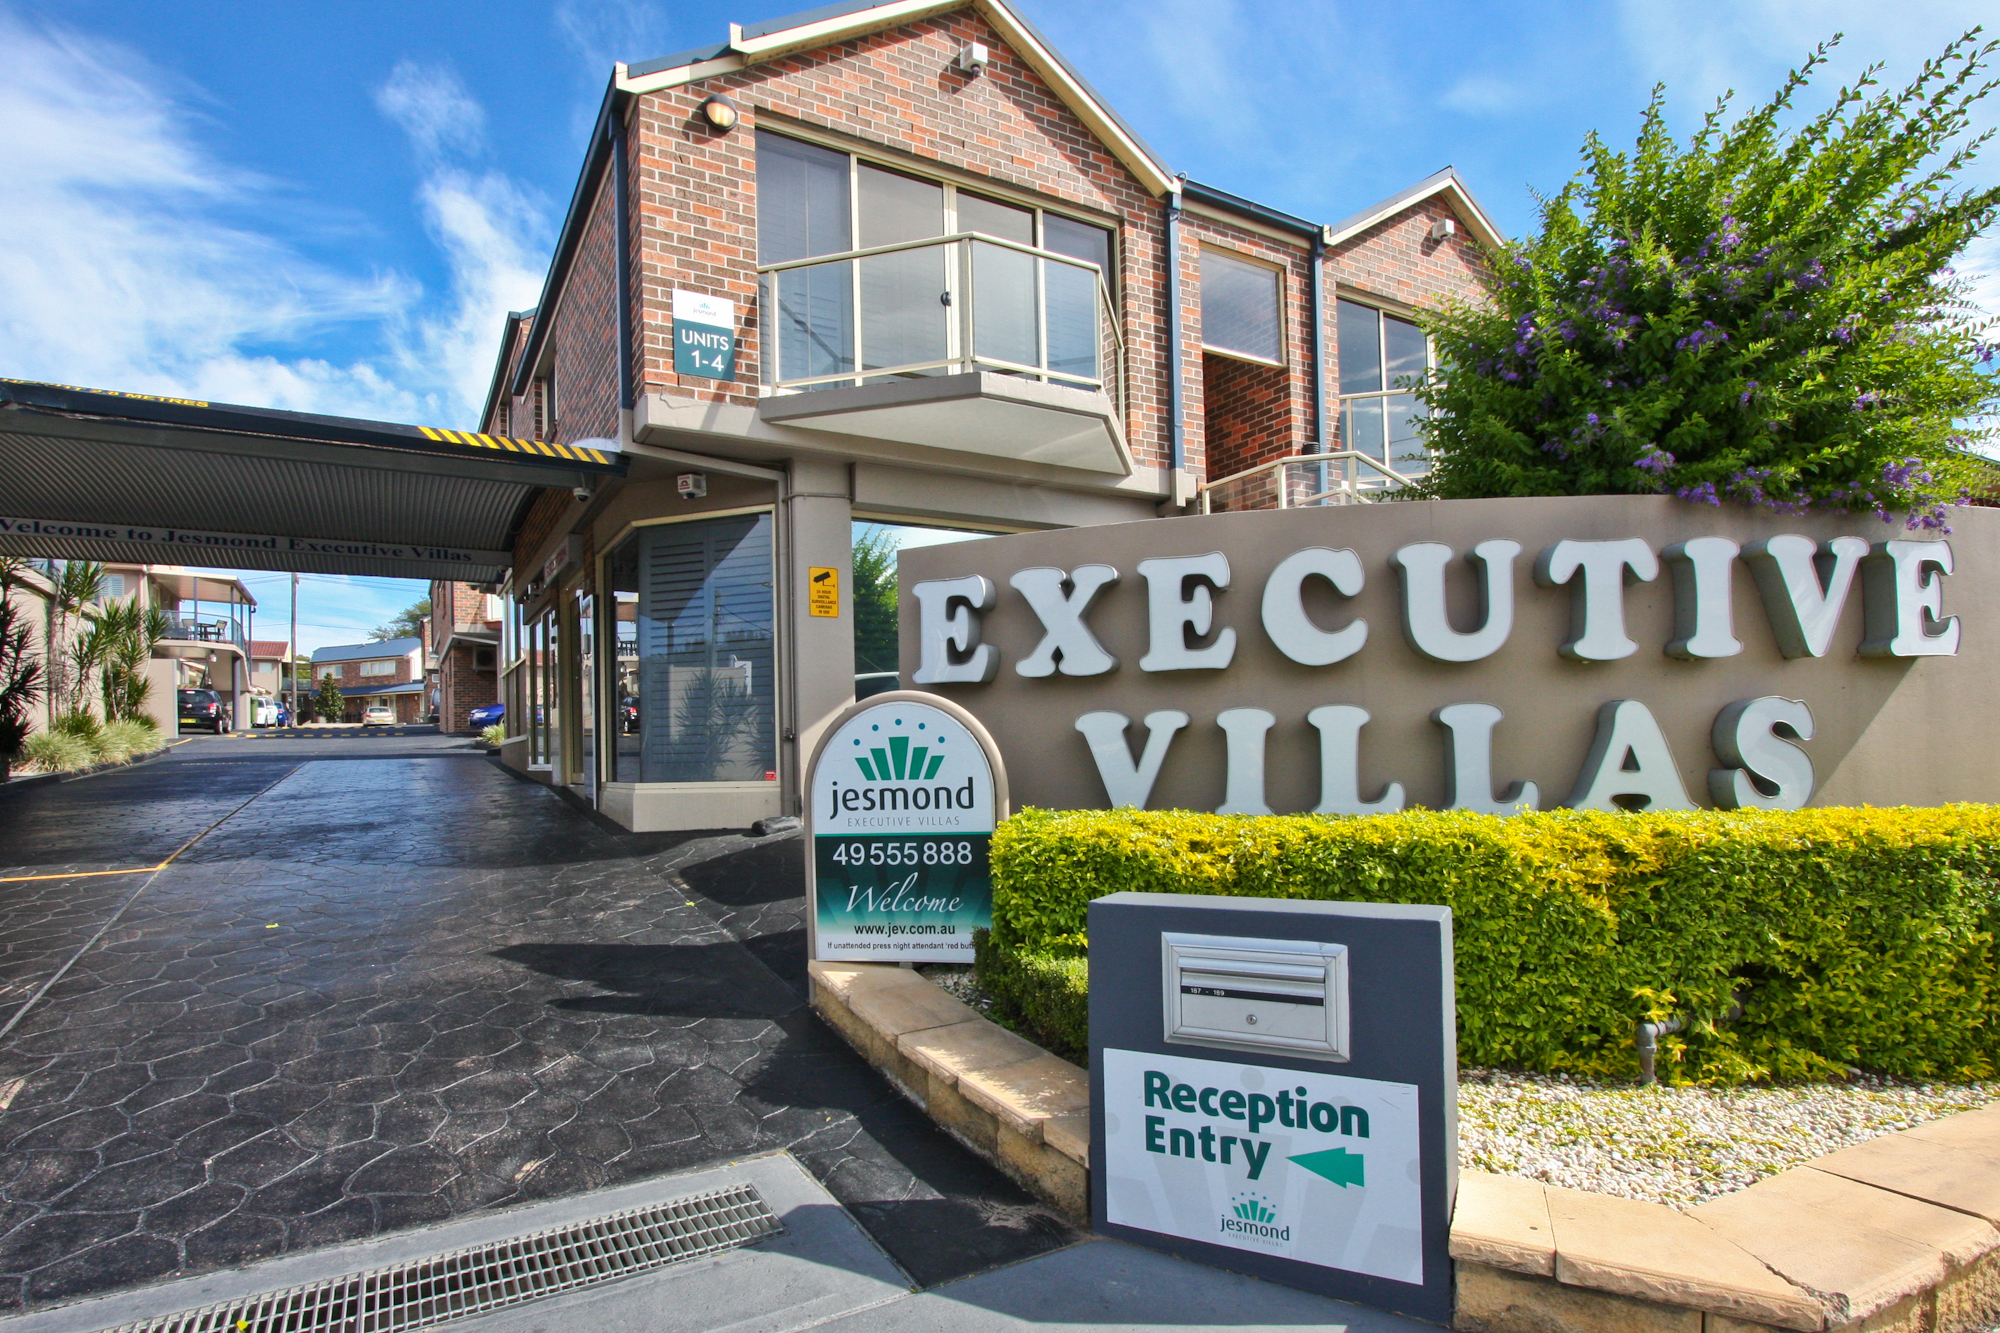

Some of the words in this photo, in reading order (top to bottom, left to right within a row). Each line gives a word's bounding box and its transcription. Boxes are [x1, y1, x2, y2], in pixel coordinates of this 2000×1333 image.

[681, 329, 730, 351] UNITS
[126, 527, 153, 541] to
[161, 529, 277, 550] Jesmond
[288, 538, 403, 558] Executive
[411, 547, 473, 562] Villas
[912, 534, 1961, 684] EXECUTIVE
[1075, 695, 1817, 815] VILLAS
[830, 777, 974, 820] jesmond
[847, 816, 911, 827] EXECUTIVE
[919, 816, 960, 826] VILLAS
[845, 871, 964, 913] Welcome
[827, 942, 832, 950] If
[834, 942, 871, 950] unattended
[873, 943, 891, 951] press
[893, 942, 911, 951] night
[912, 941, 944, 950] attendant
[854, 922, 956, 938] www.jev.com.au
[1143, 1070, 1370, 1139] Reception
[1145, 1115, 1272, 1181] Entry
[1220, 1214, 1290, 1241] jesmond
[1228, 1232, 1259, 1243] EXECUTIVE
[1261, 1239, 1283, 1248] VILLAS
